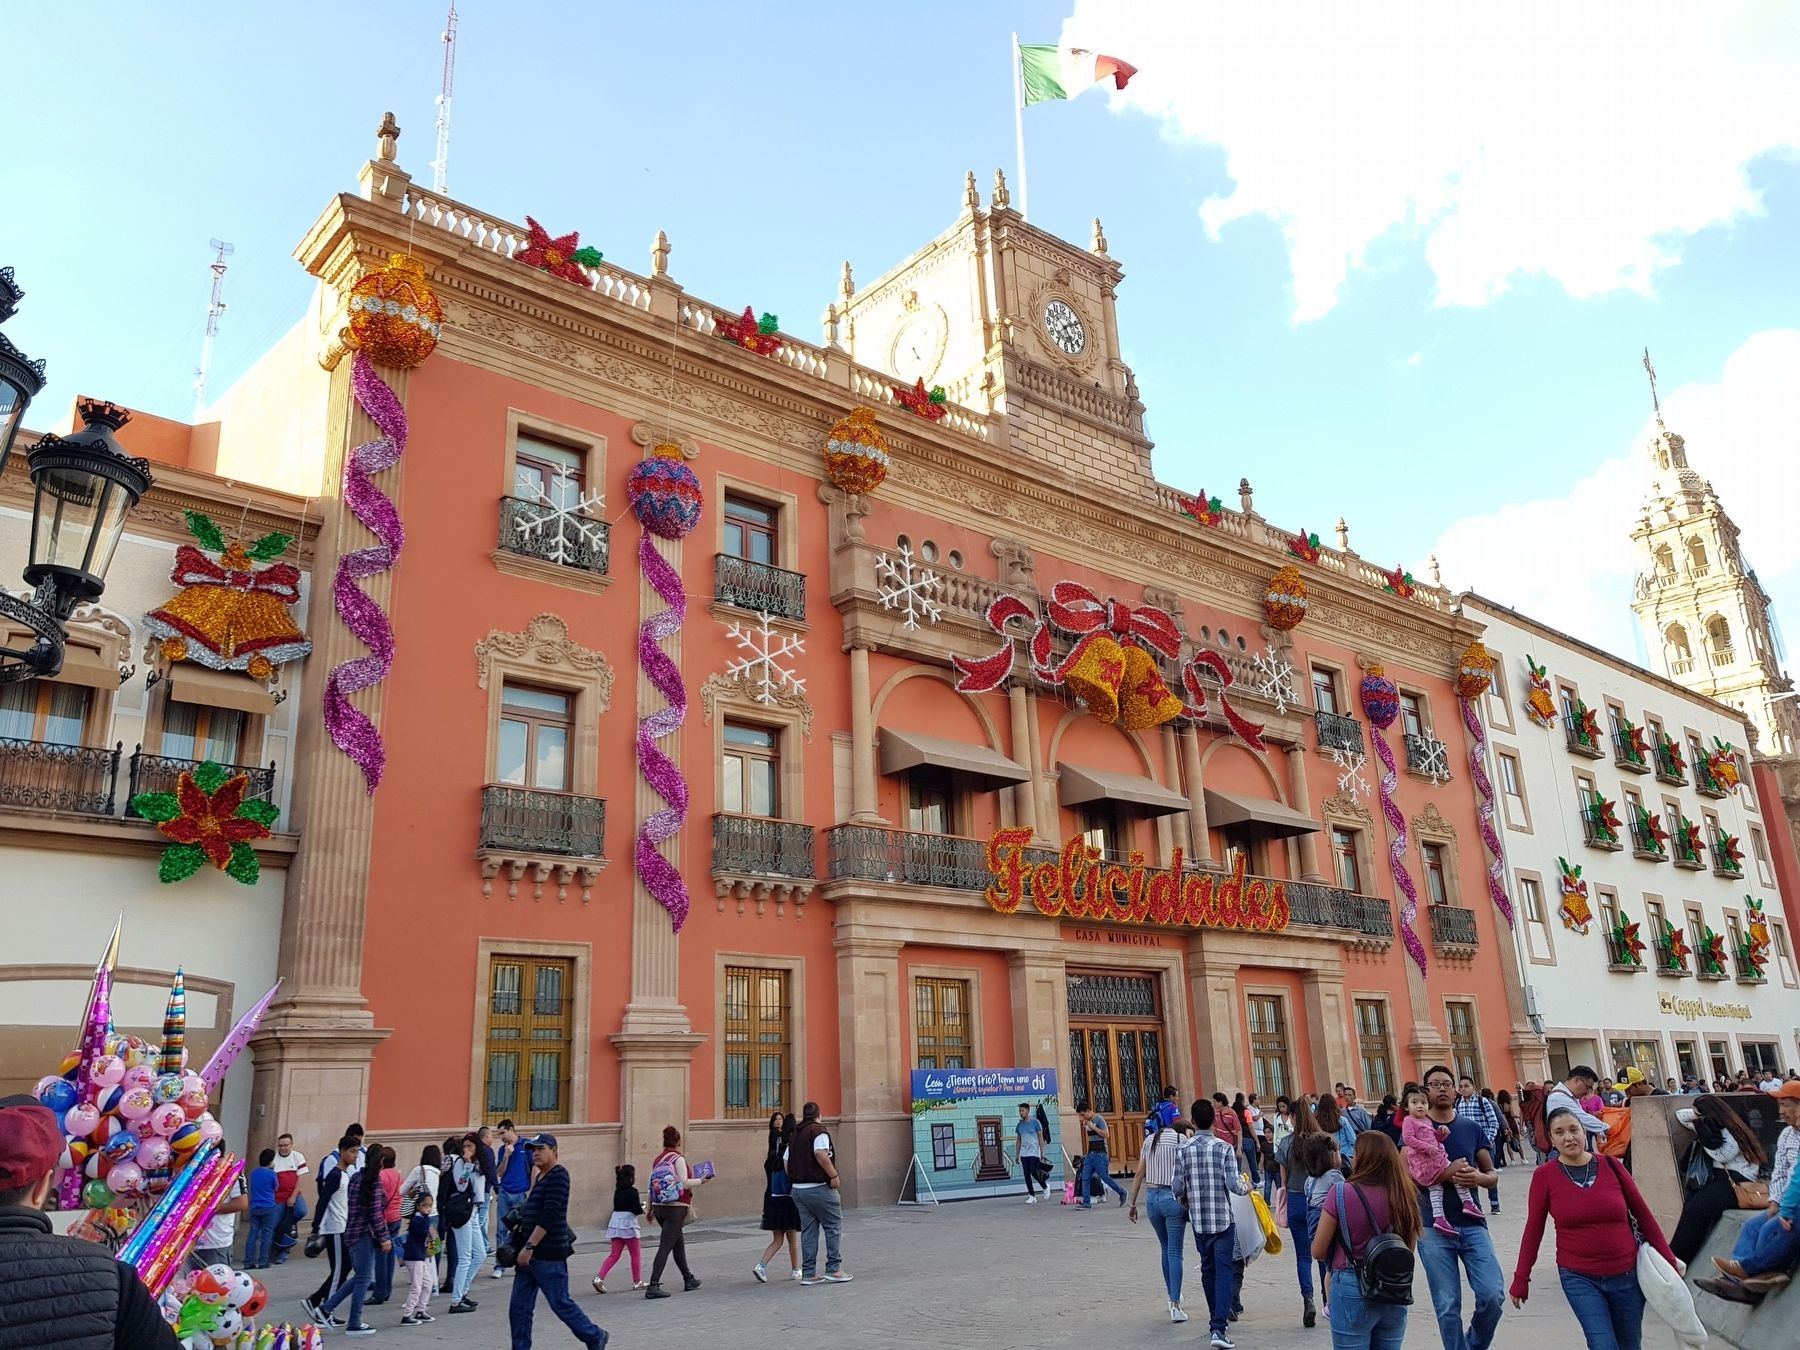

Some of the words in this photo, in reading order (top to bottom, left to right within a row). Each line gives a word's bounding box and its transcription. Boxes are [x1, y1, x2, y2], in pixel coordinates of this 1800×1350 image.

[984, 825, 1290, 931] Felicidades
[1075, 929, 1101, 942] CASA
[1107, 932, 1162, 947] MUNICIPAL
[1672, 995, 1707, 1021] Coppel
[946, 1074, 976, 1088] ¿Tienes
[997, 1073, 1015, 1084] Toma
[1016, 1075, 1029, 1084] uno
